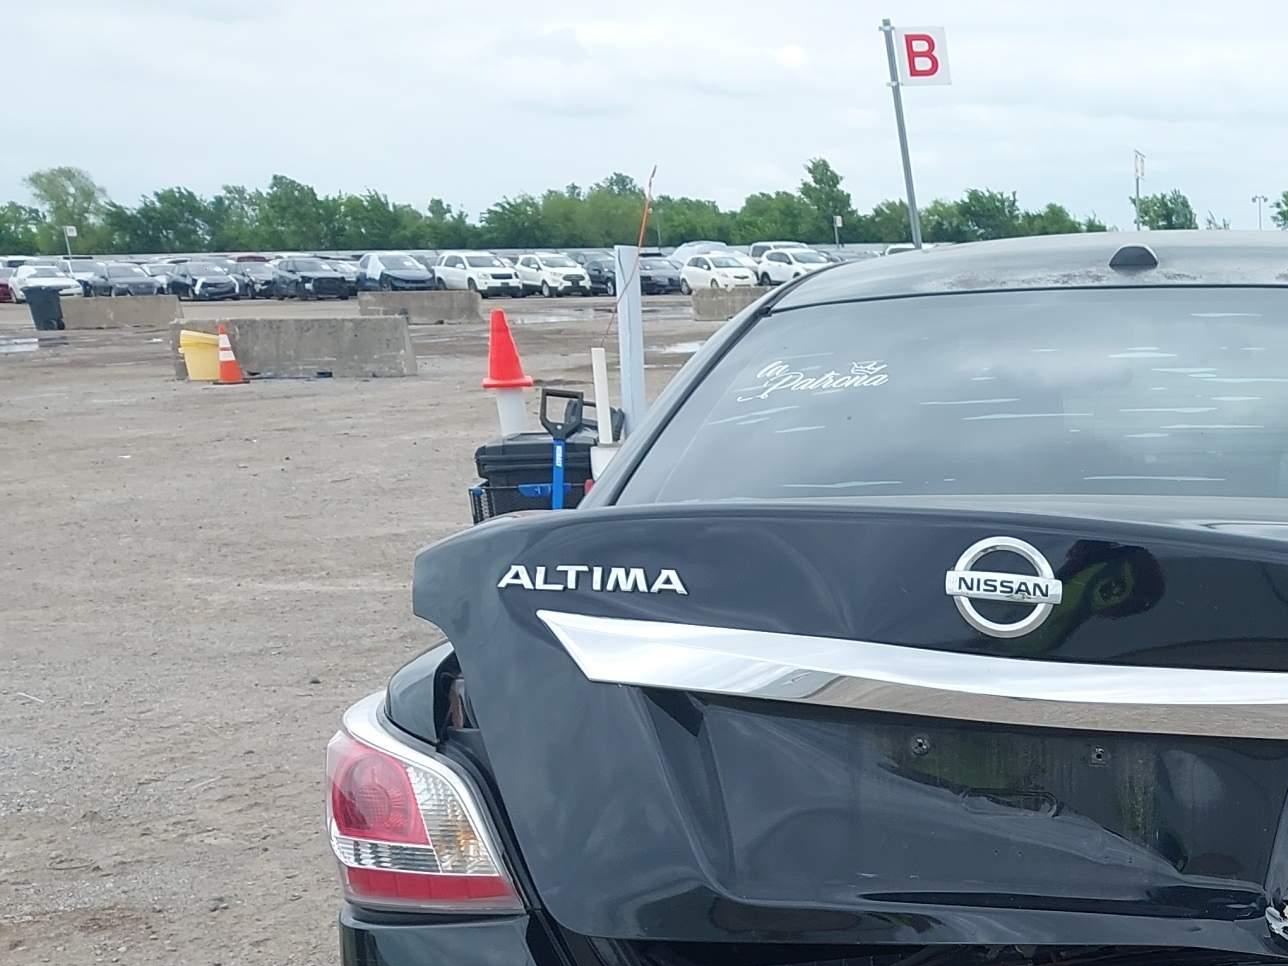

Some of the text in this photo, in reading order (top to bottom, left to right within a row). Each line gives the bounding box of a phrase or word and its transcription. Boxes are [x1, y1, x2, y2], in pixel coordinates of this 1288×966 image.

[904, 34, 939, 77] B
[497, 565, 689, 595] ALTIMA
[958, 576, 1050, 598] NISSAN
